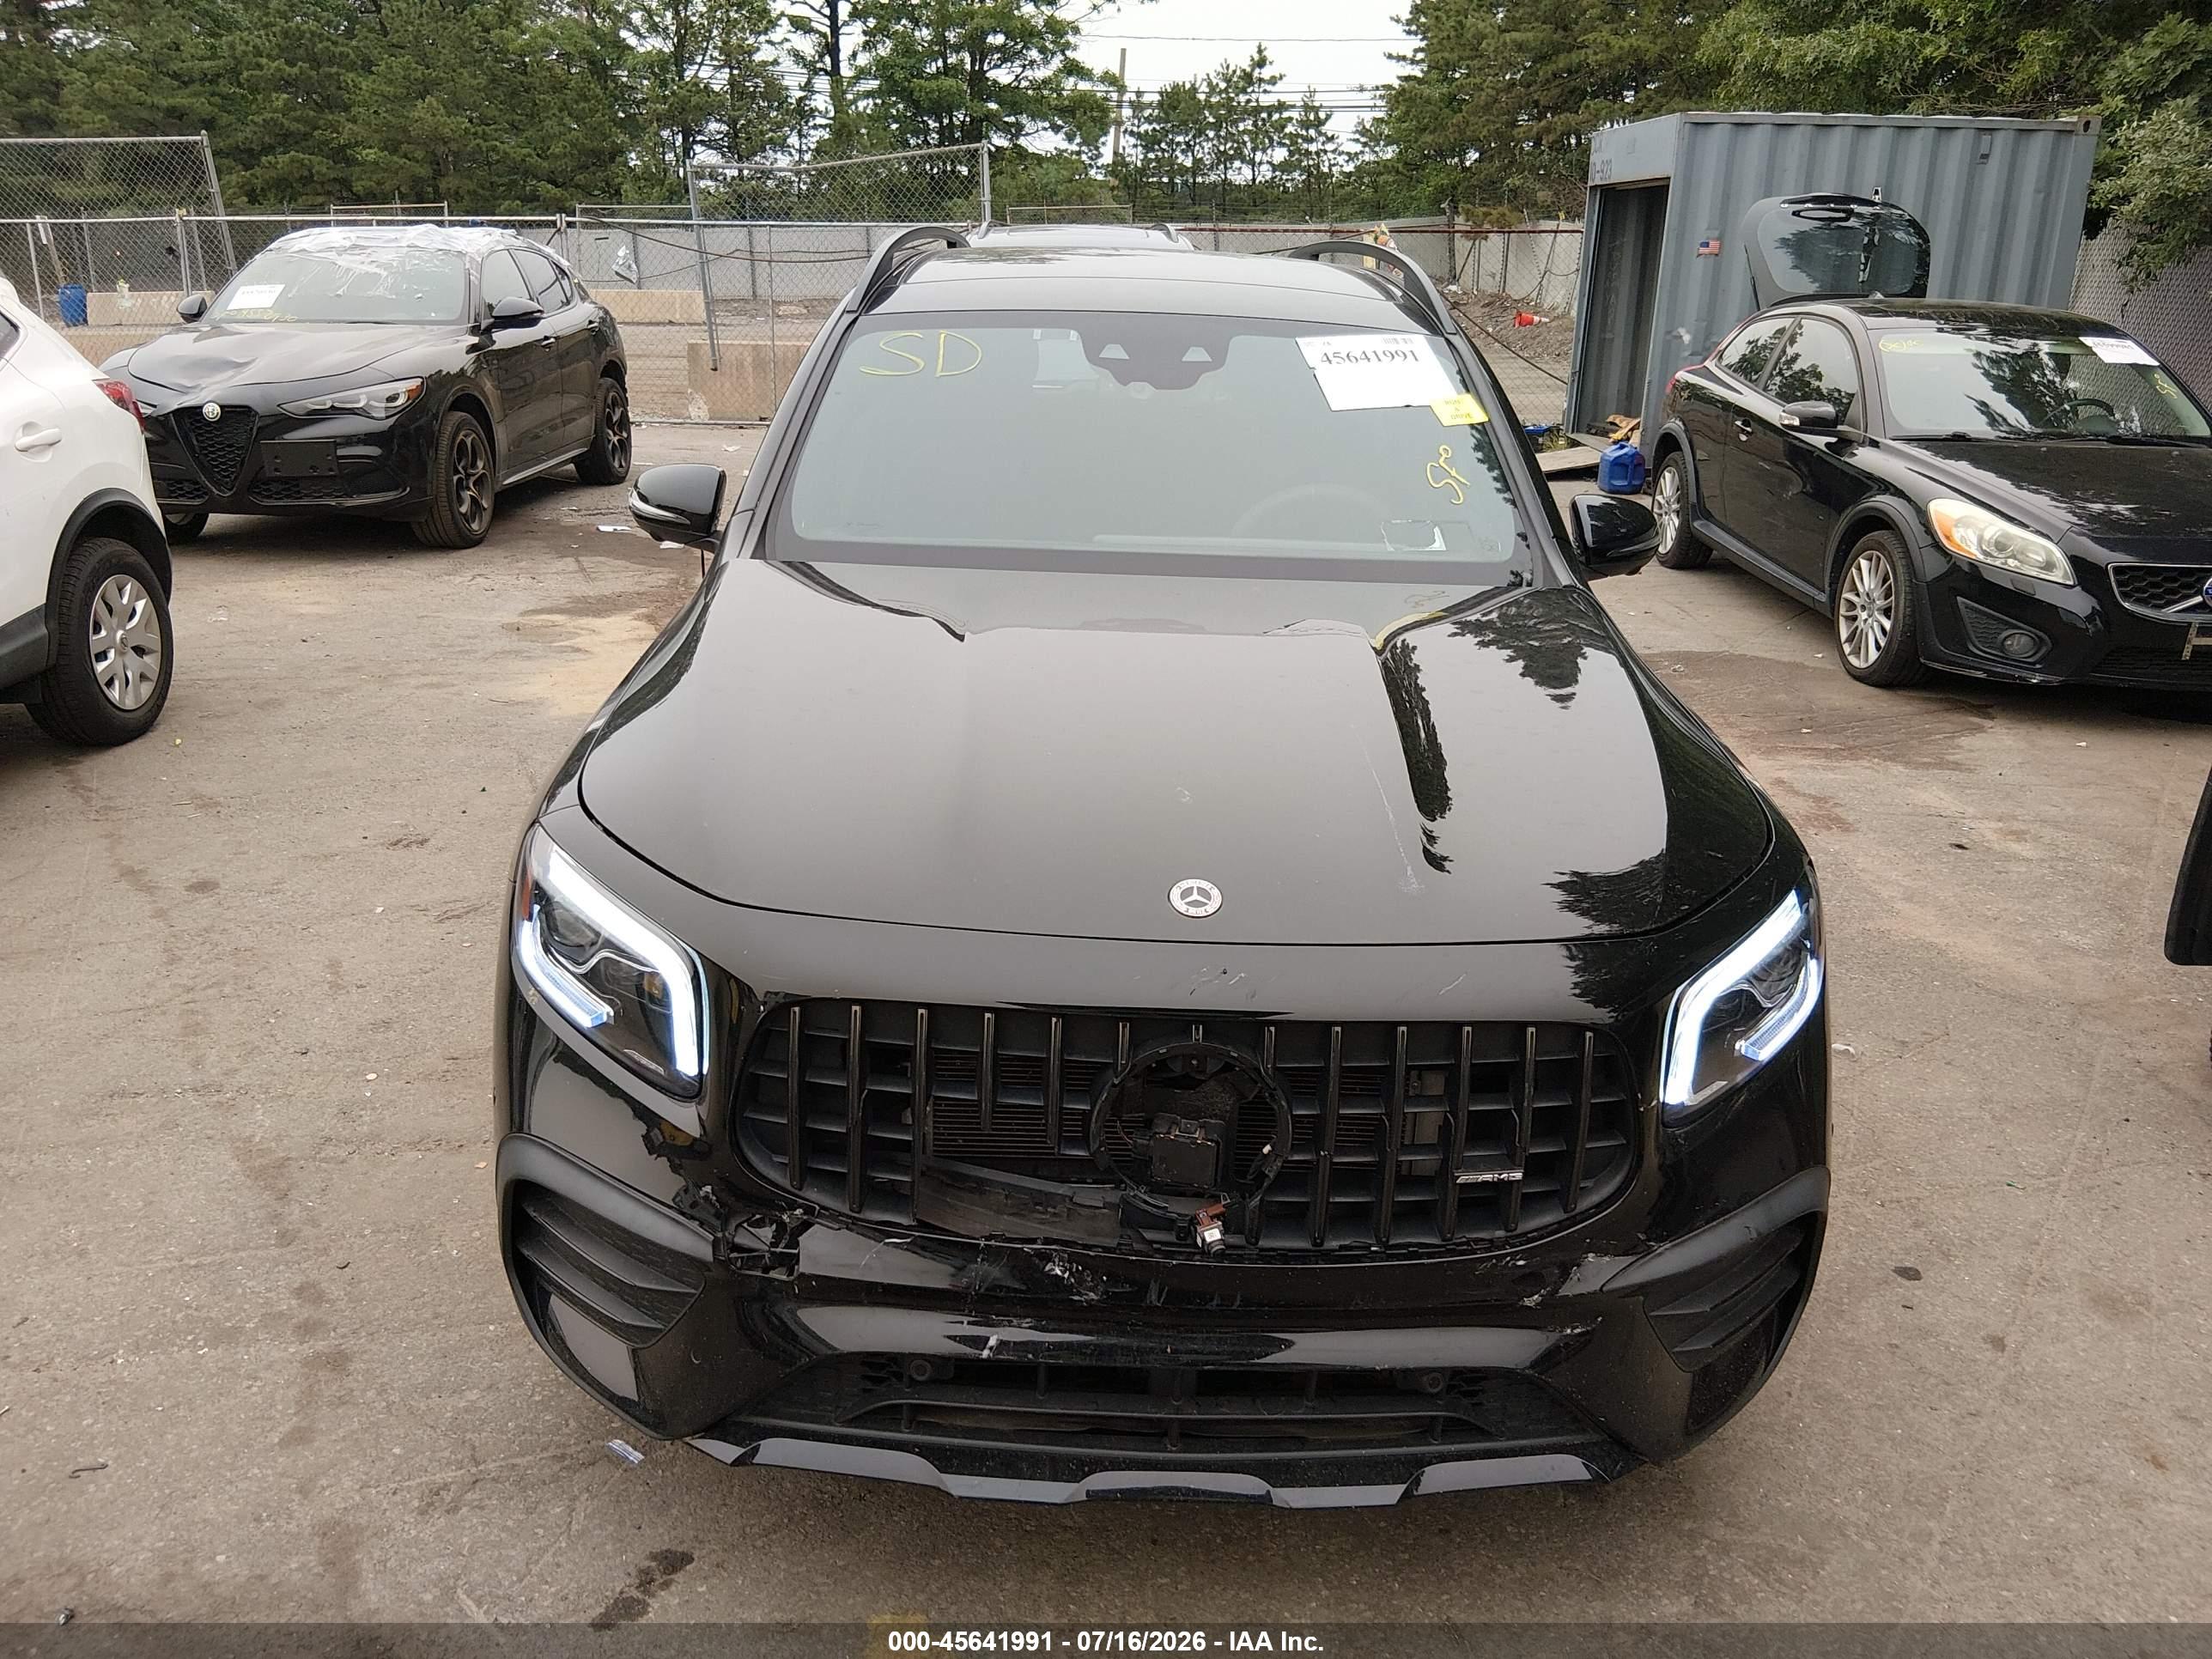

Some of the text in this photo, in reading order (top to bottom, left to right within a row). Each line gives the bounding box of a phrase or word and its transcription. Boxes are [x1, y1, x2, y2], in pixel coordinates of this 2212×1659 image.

[859, 330, 982, 377] SD
[1321, 349, 1419, 365] 45641991
[1477, 1171, 1523, 1182] AMG
